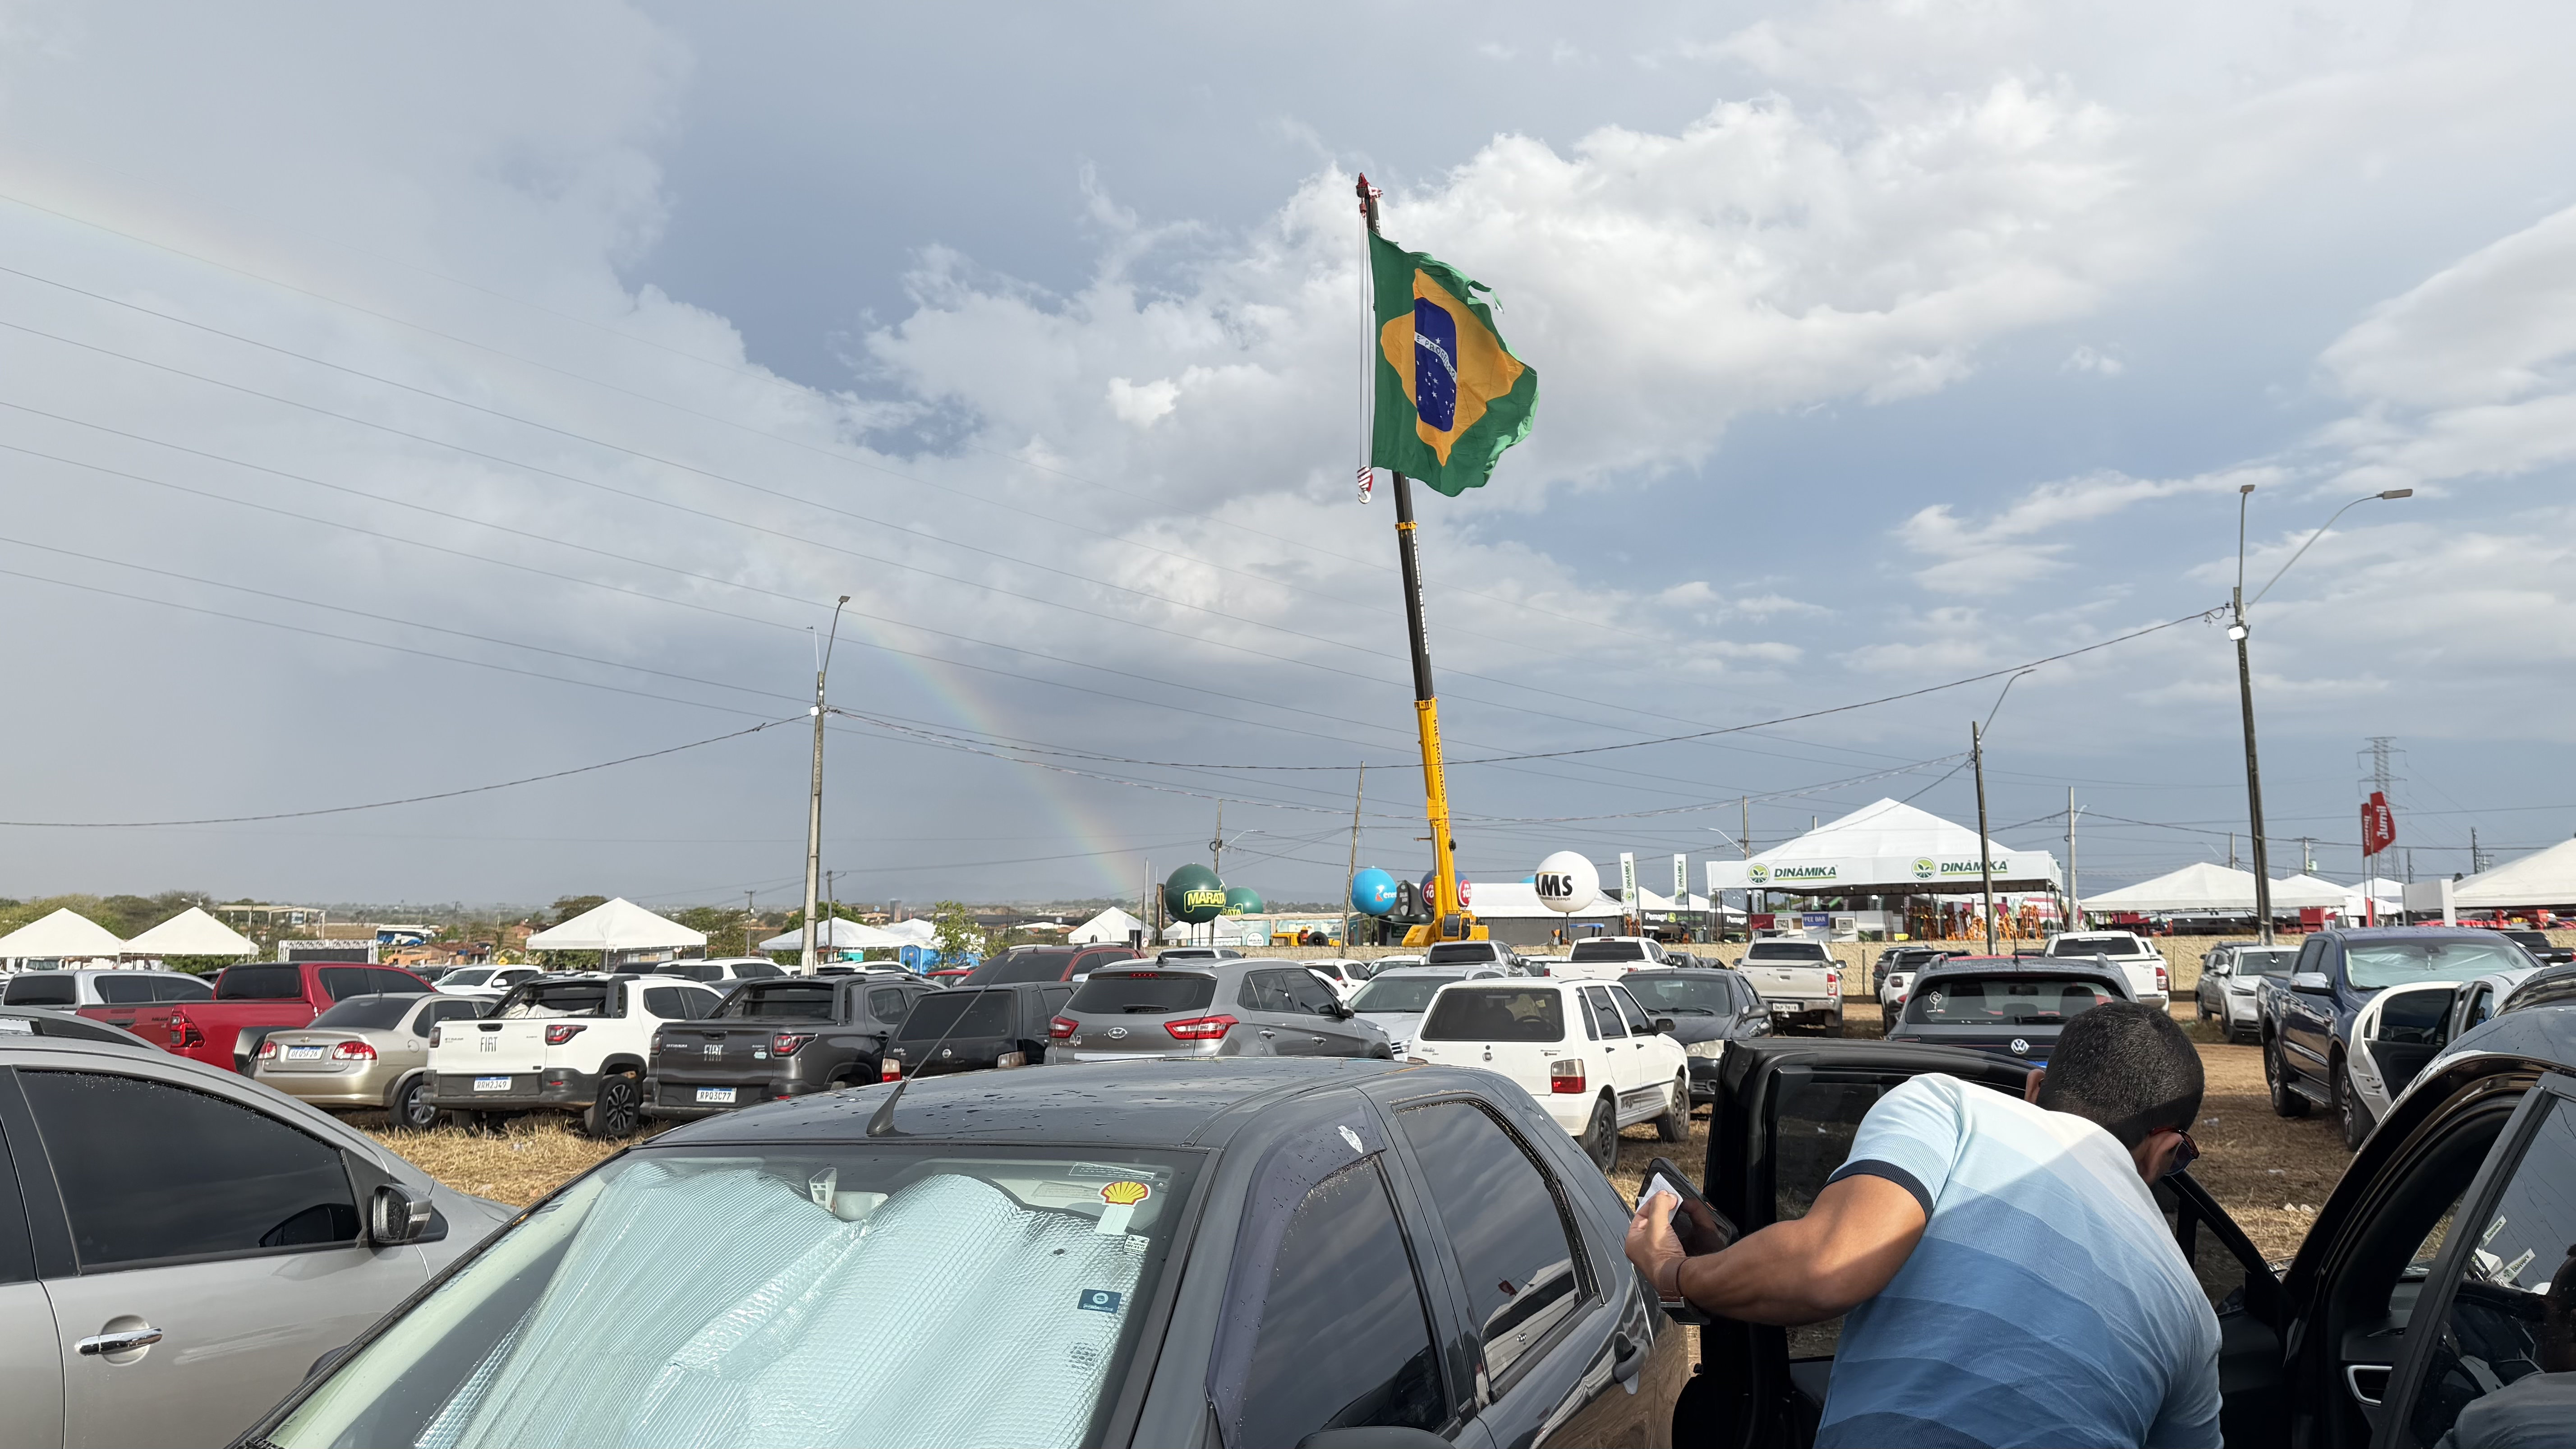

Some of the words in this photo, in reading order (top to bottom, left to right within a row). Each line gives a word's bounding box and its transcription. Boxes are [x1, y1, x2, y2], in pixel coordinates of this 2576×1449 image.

[2376, 805, 2389, 840] Jumil
[1774, 865, 1836, 877] DINÂMIKA
[1941, 860, 2008, 872] DINÂMKA
[1645, 912, 1667, 922] Pemagri
[480, 1037, 498, 1053] FIAT
[704, 1044, 723, 1061] FIAT
